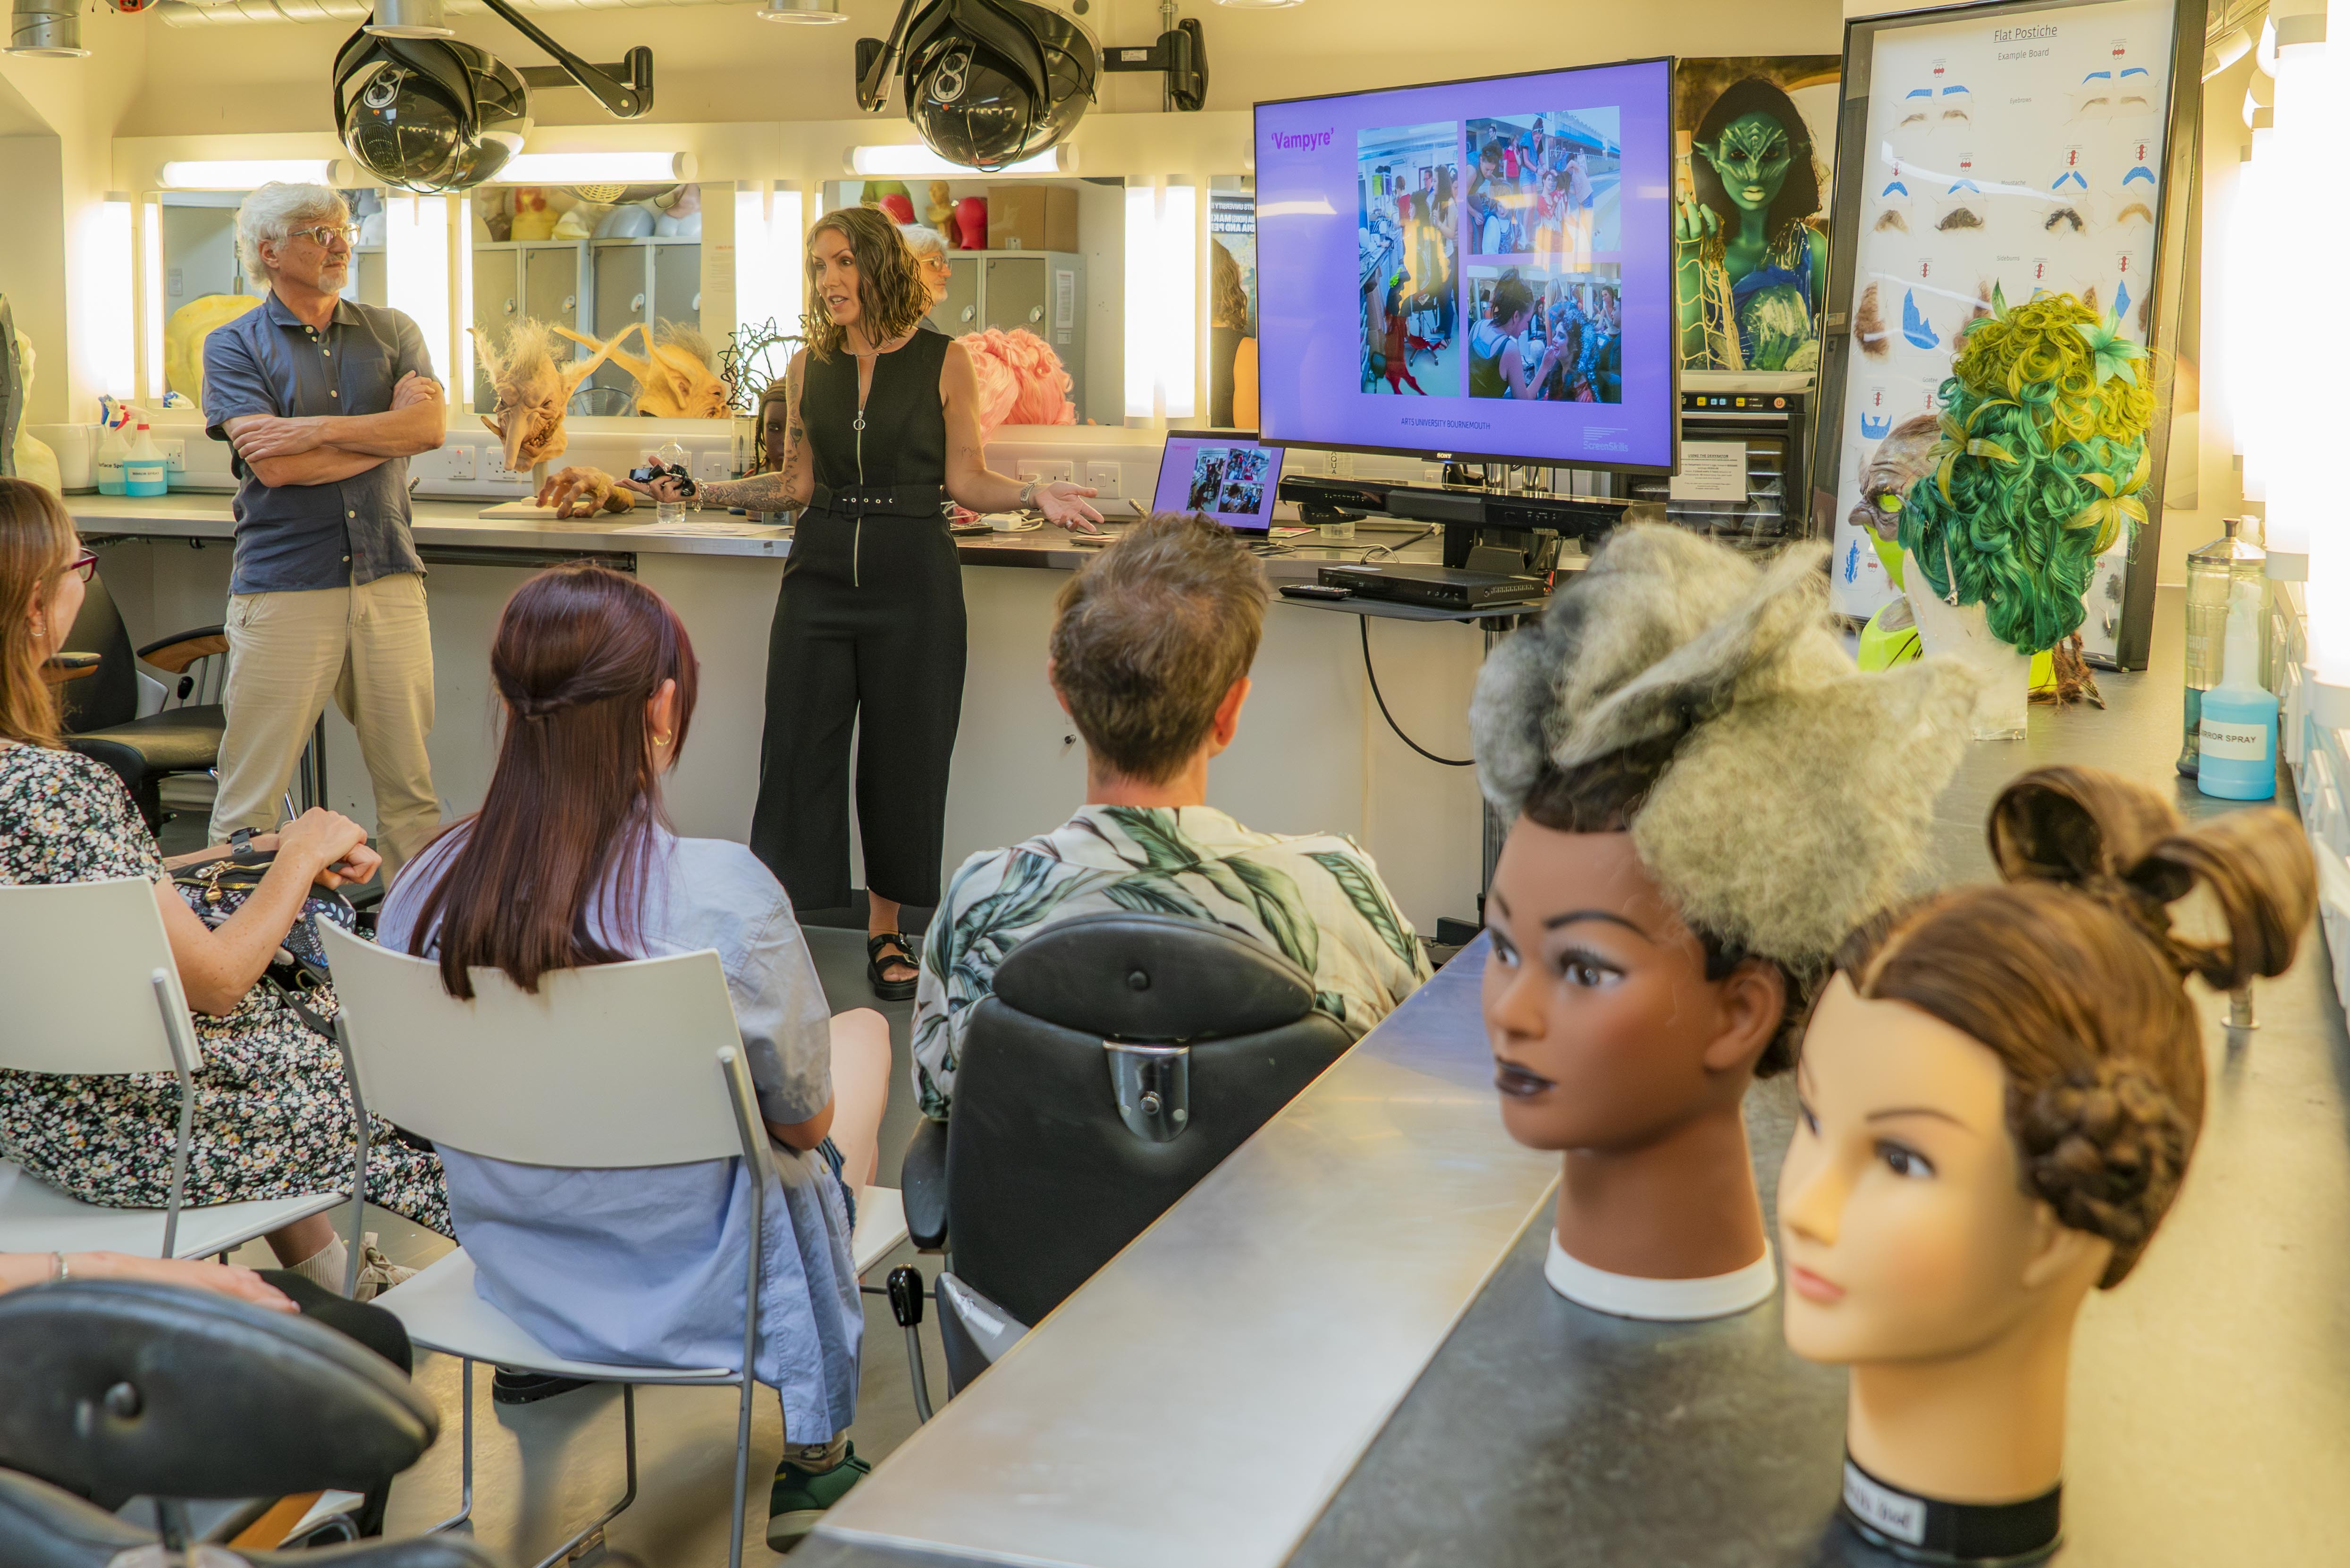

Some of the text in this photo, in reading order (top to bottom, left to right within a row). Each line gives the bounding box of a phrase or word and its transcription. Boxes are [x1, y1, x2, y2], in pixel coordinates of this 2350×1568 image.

[1994, 25, 2057, 42] Flat Postiche
[1998, 47, 2049, 60] Example Board
[1401, 418, 1491, 430] ARTS UNIVERSITY BOURNEMOUTH
[2225, 735, 2256, 743] SPRAY
